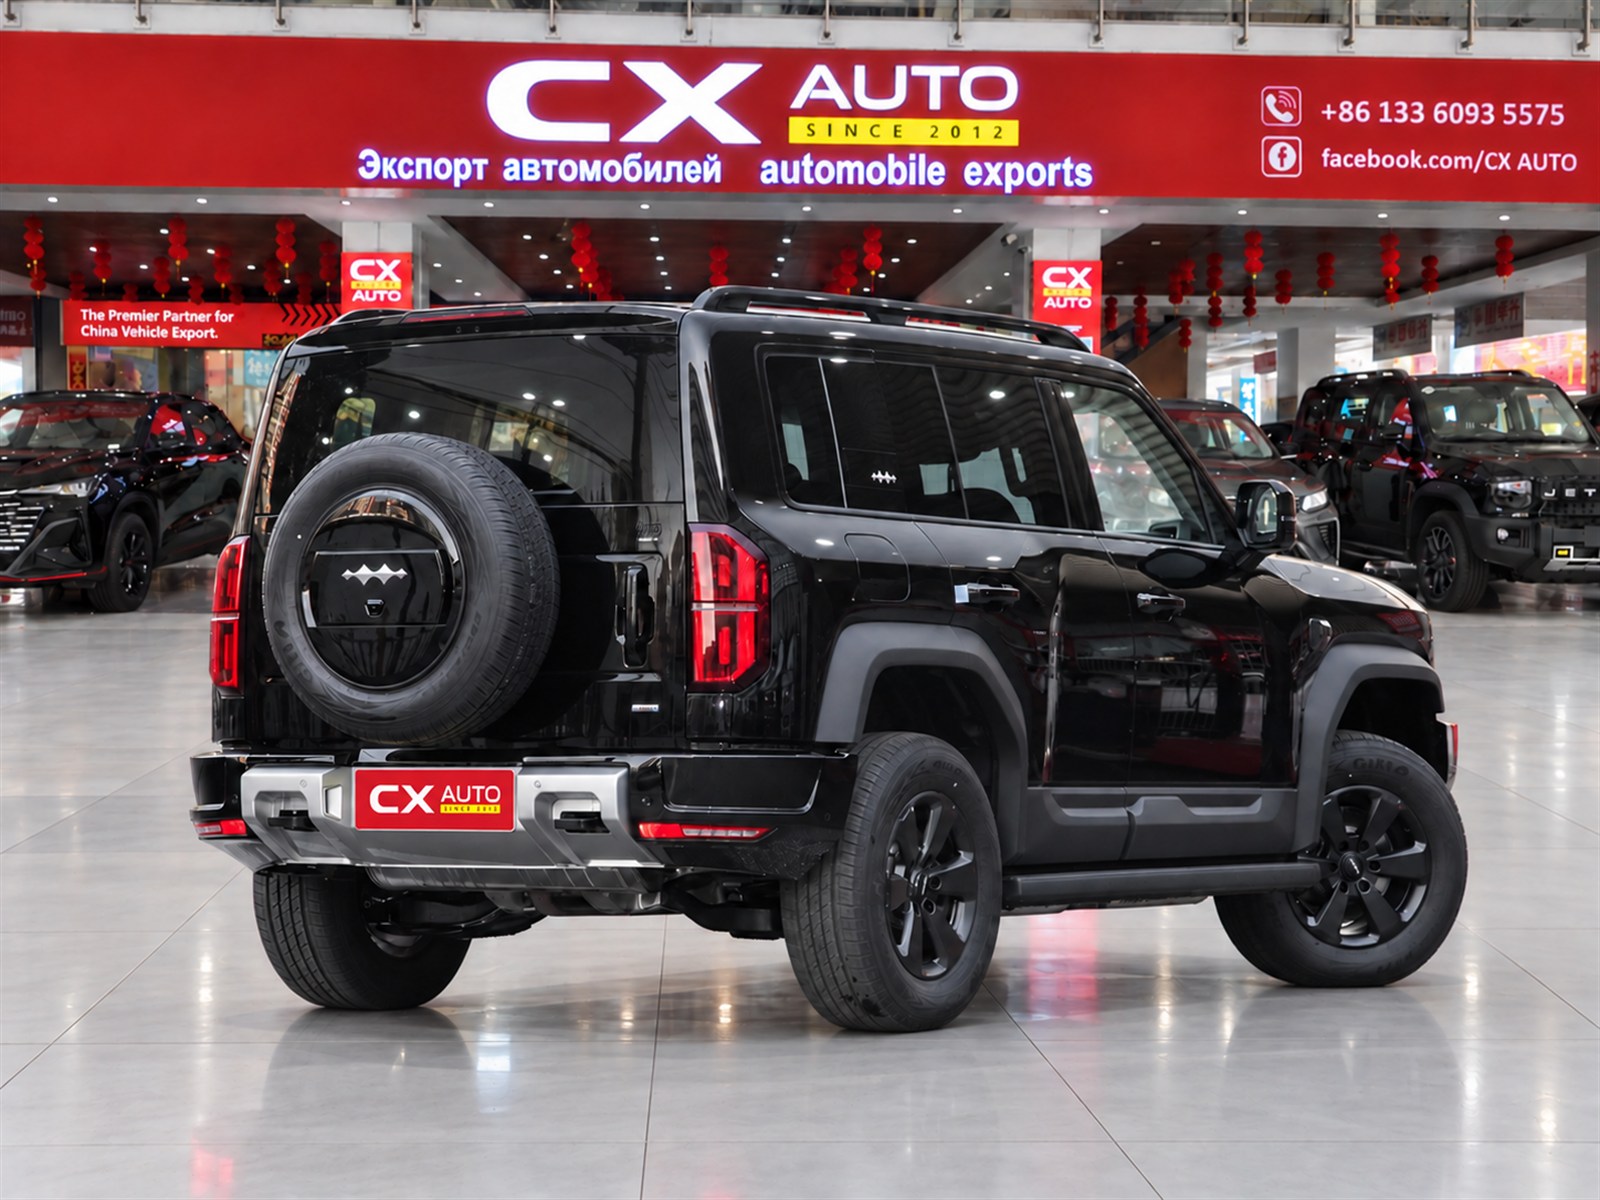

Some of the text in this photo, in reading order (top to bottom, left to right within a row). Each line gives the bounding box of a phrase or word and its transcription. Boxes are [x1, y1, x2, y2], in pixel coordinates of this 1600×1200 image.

[486, 60, 1019, 144] CX AUTO
[1321, 100, 1565, 126] +86 133 6093 5575
[806, 123, 1003, 140] SINCE 2012
[358, 149, 722, 188] Экспорт автомобилей
[1321, 148, 1577, 174] facebook.com/CX AUTO
[759, 152, 1094, 194] automobile exports
[350, 259, 402, 281] CX
[1042, 266, 1093, 288] CX
[351, 290, 402, 302] AUTO
[1043, 297, 1092, 309] AUTO
[80, 309, 235, 323] The Premier Partner for
[80, 325, 219, 341] China Vehicle Export.
[369, 784, 501, 814] CX AUTO
